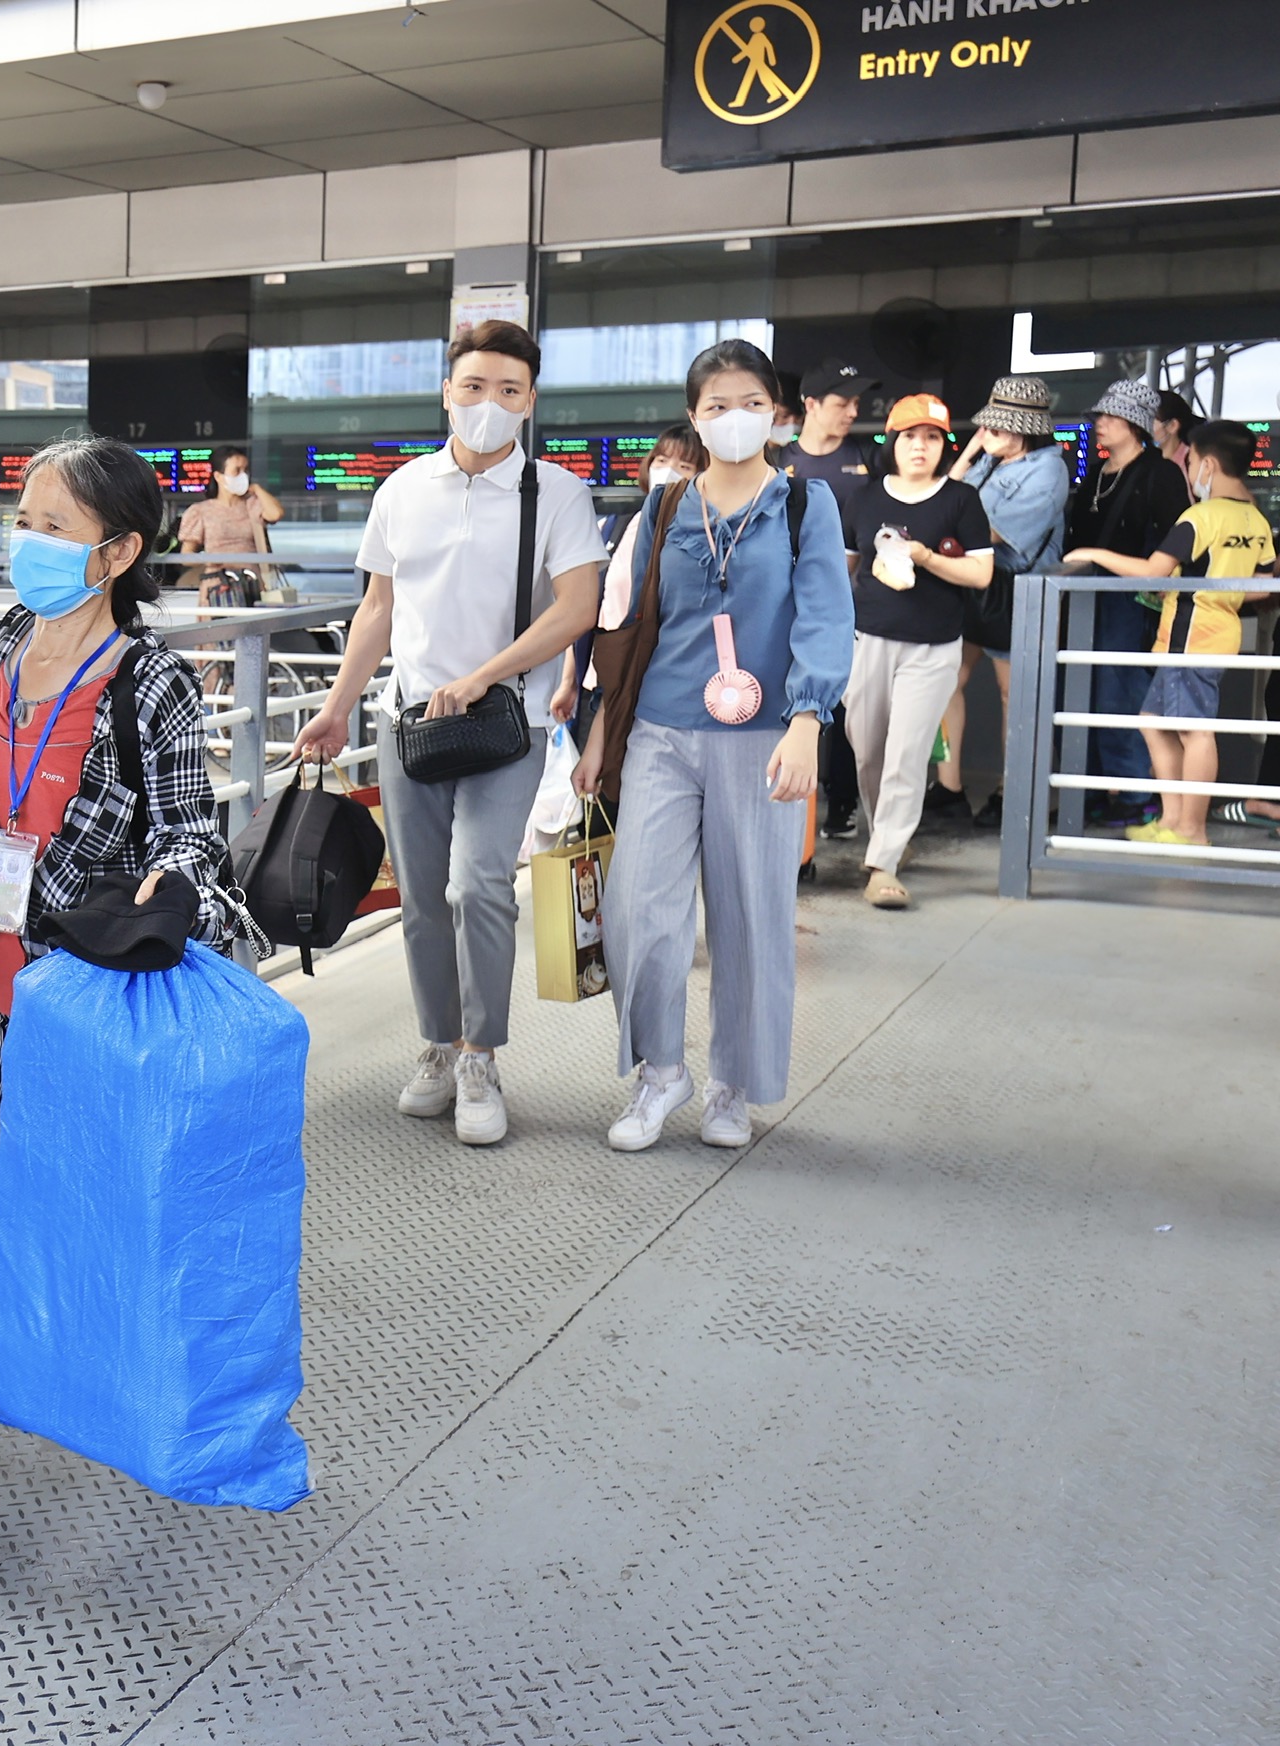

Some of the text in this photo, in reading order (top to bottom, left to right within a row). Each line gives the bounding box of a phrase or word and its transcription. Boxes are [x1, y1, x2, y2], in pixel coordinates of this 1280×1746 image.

[859, 36, 1032, 80] Entry Only
[128, 423, 147, 438] 17
[193, 421, 214, 437] 18
[339, 417, 361, 433] 20
[40, 771, 65, 783] POSTA
